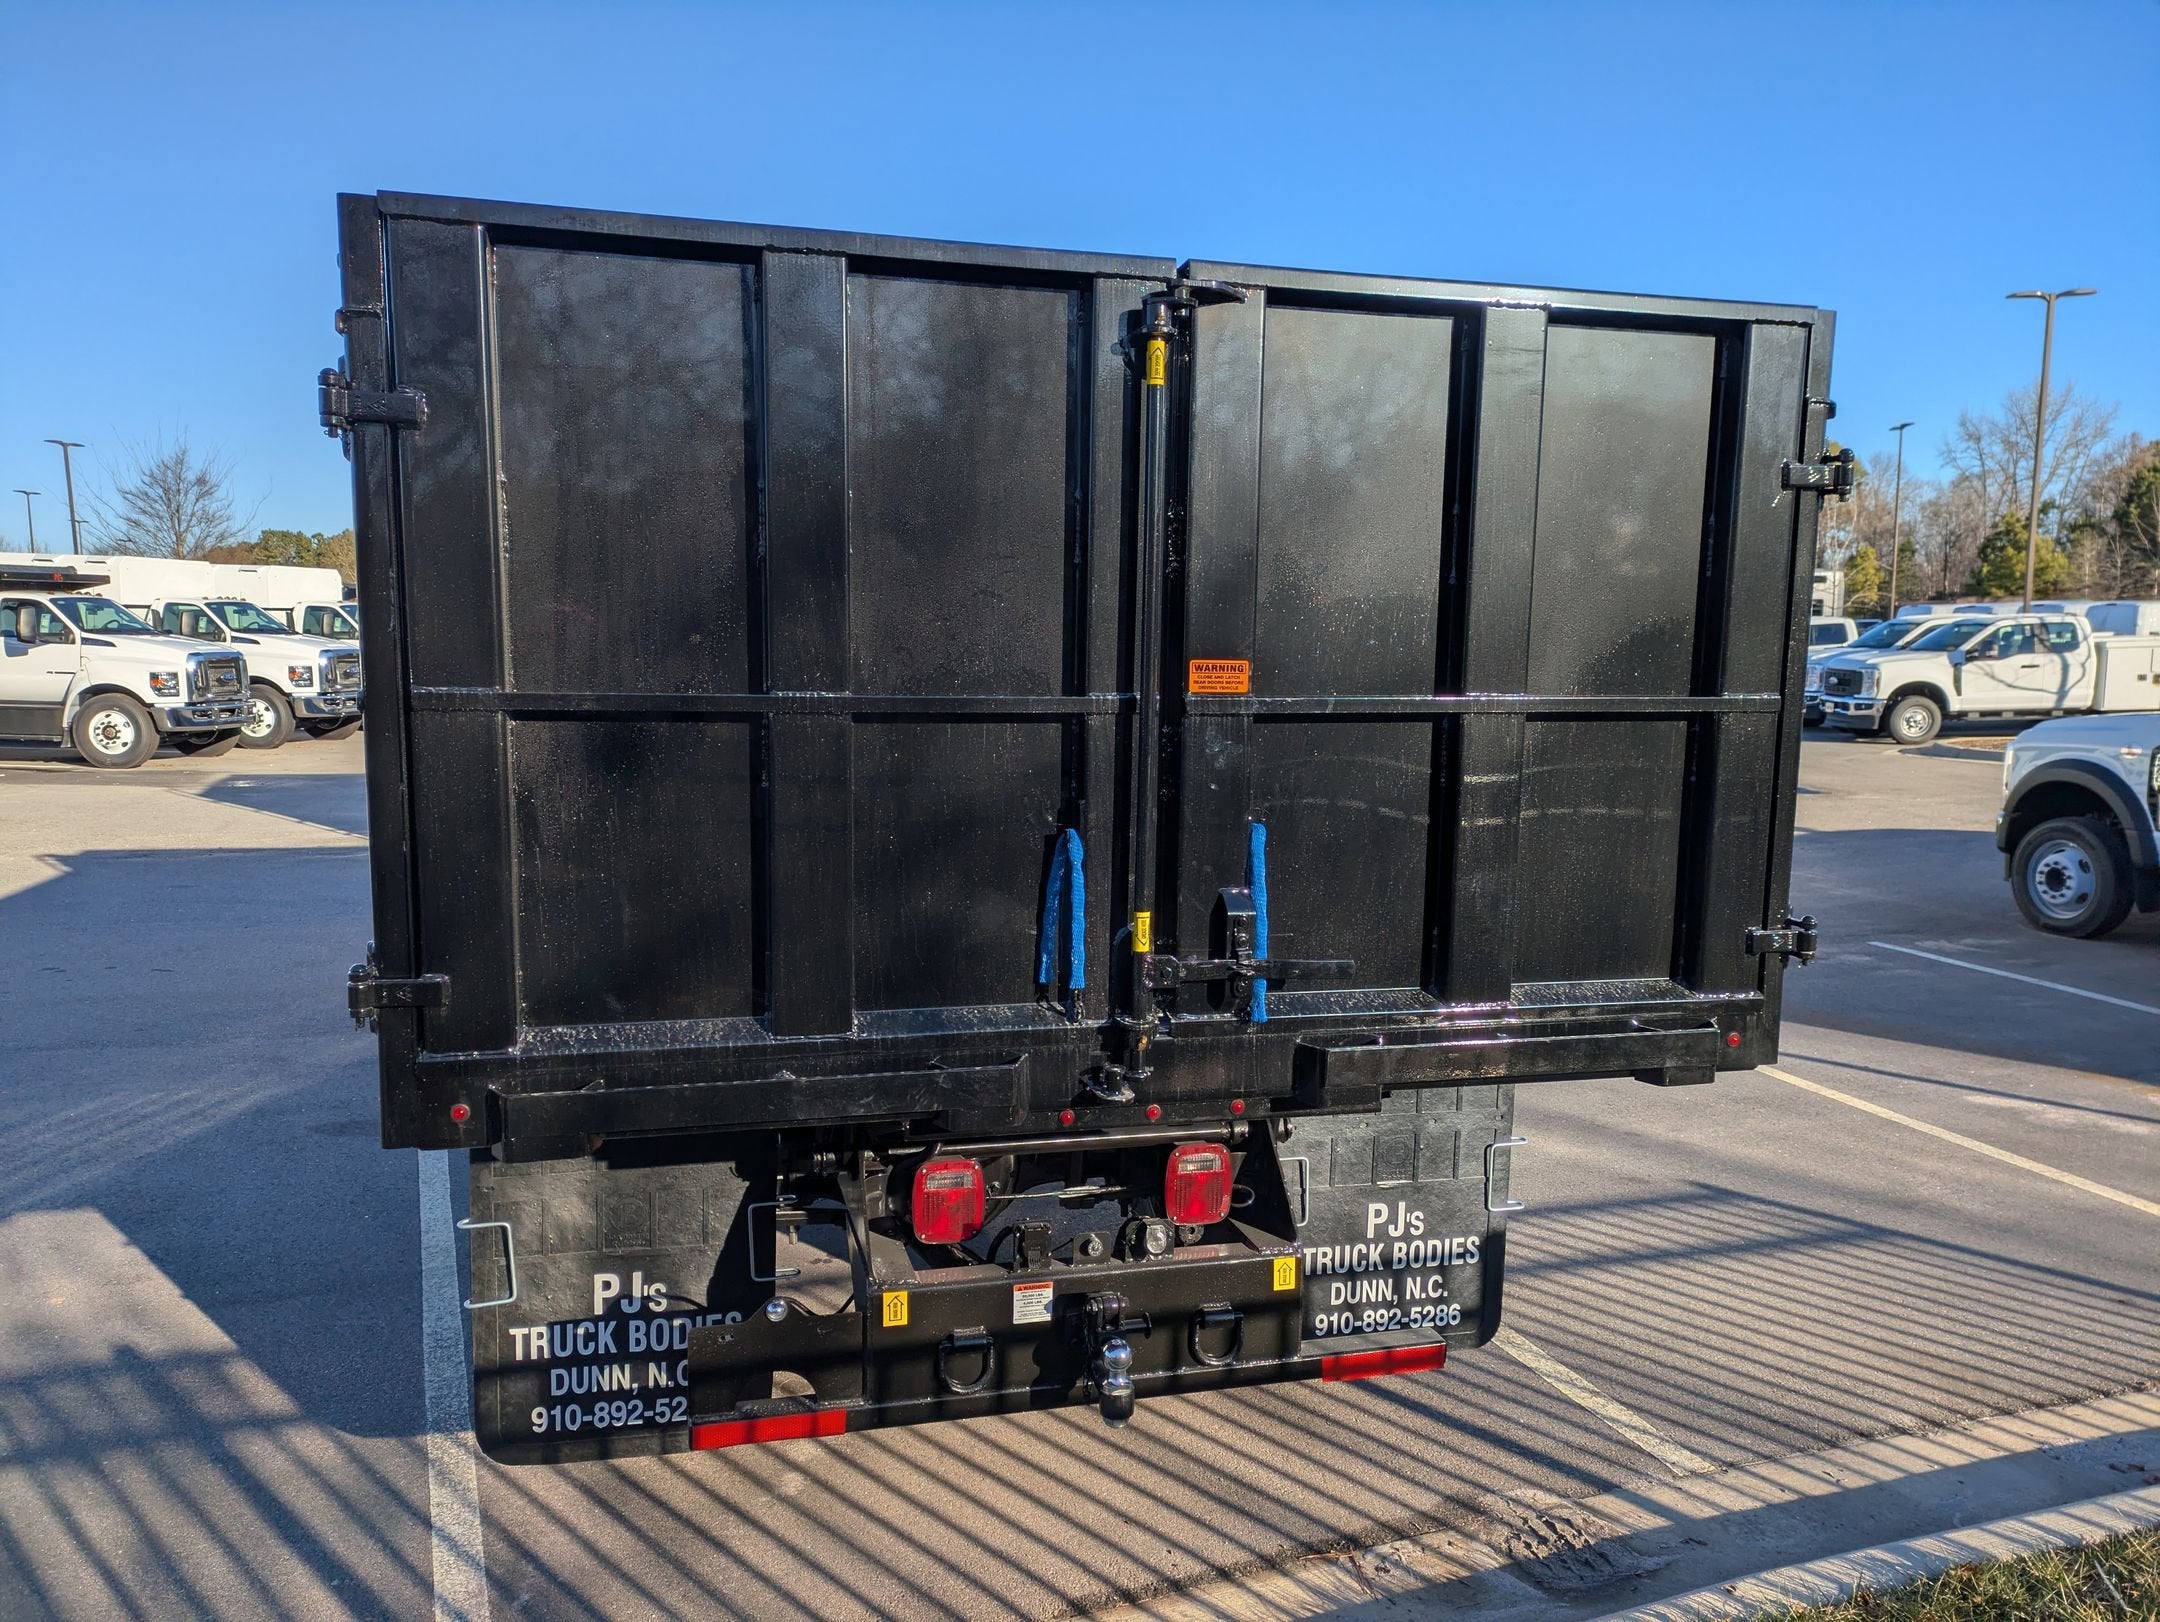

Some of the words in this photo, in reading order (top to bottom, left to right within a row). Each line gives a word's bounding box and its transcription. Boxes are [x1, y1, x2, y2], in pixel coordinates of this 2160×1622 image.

[1194, 664, 1244, 673] WARNING
[1303, 1243, 1384, 1276] TRUCK
[1392, 1235, 1481, 1271] BODIES
[1330, 1278, 1399, 1306] DUNN,
[1405, 1274, 1449, 1300] N.C.
[508, 1320, 618, 1361] TRUCK
[629, 1311, 742, 1353] BOD
[1314, 1303, 1462, 1337] 910-892-5286
[550, 1363, 639, 1396] DUNN,
[648, 1359, 689, 1389] N.C
[530, 1396, 689, 1433] 910-892-52
